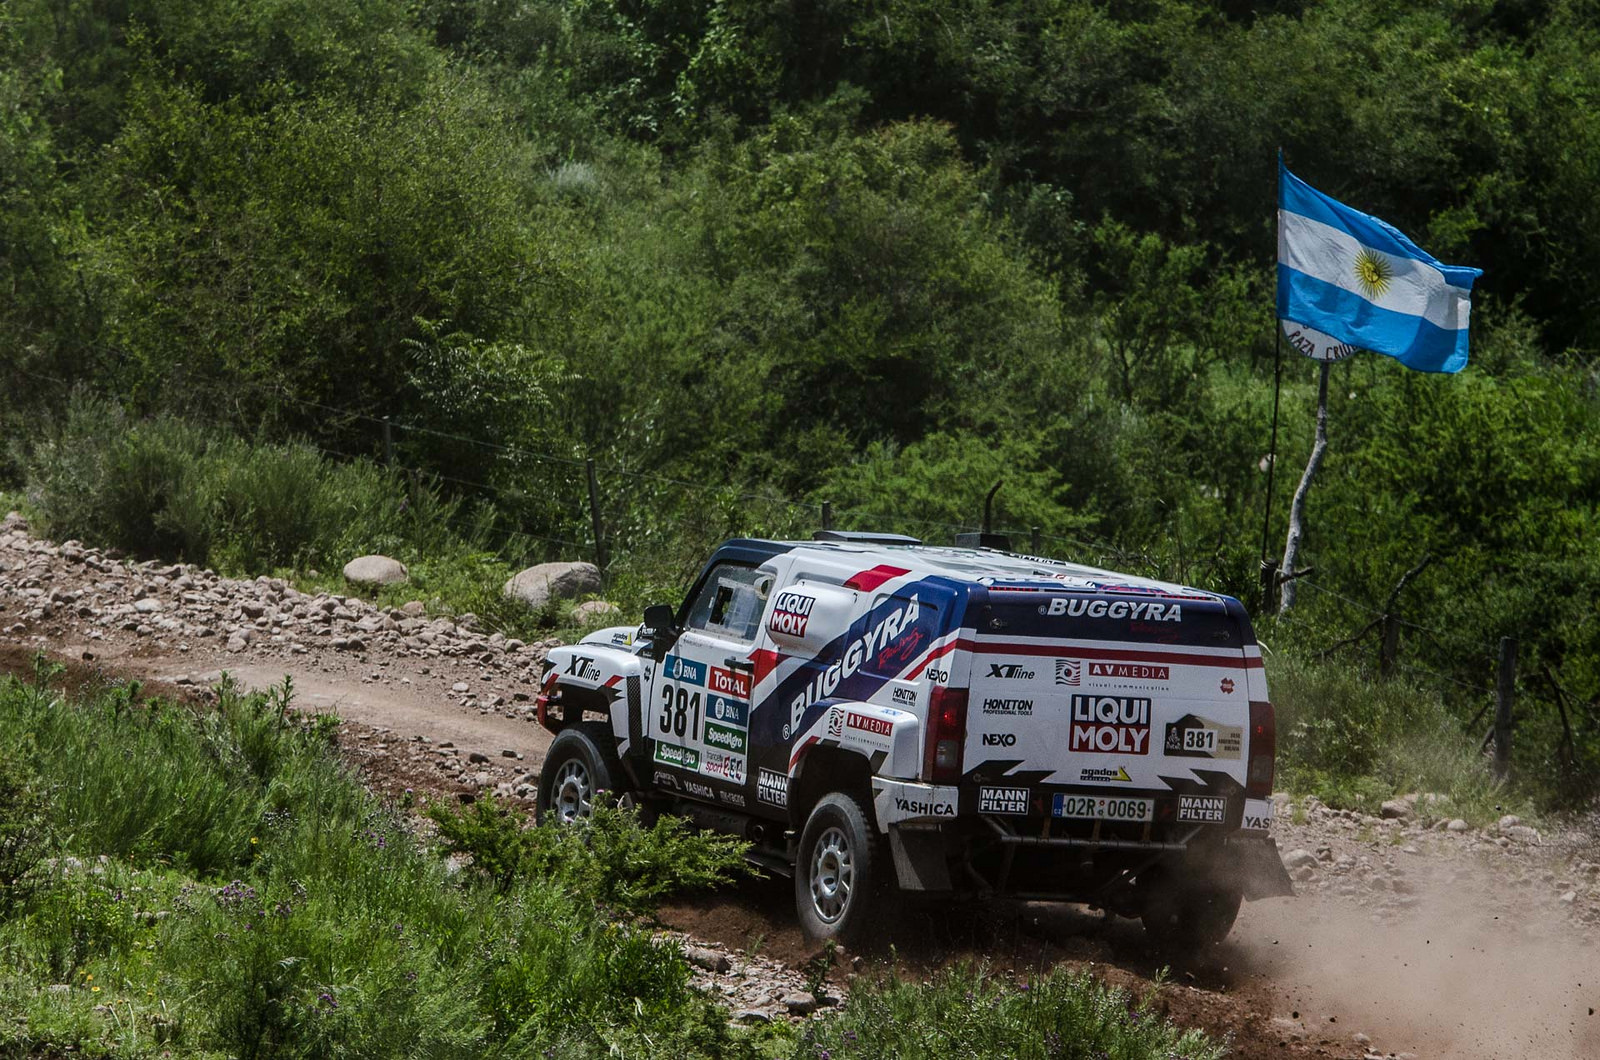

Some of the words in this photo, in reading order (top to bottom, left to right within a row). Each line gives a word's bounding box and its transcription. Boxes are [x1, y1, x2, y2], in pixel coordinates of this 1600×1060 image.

[1288, 331, 1315, 357] RAZA
[776, 592, 815, 616] LIQUI
[1047, 598, 1182, 622] BUGGYRA
[771, 611, 807, 636] MOLY
[564, 654, 601, 681] XTline
[683, 665, 697, 680] BNA
[790, 593, 920, 735] BUGGYRA
[985, 664, 1035, 679] XTline
[925, 668, 948, 683] NEXO
[893, 687, 918, 702] HONITON
[660, 684, 701, 740] 381
[726, 705, 739, 719] BNA
[983, 698, 1033, 711] HONITON
[1074, 696, 1148, 725] LIQUI
[983, 734, 1016, 747] NEXO
[1073, 725, 1149, 753] MOLY
[1186, 731, 1214, 749] 381
[705, 761, 722, 774] sport
[1081, 768, 1118, 778] agados
[684, 780, 715, 799] YASHICA
[760, 771, 787, 791] MANN
[759, 786, 787, 806] FILTER
[982, 789, 1027, 801] MANN
[1180, 797, 1224, 809] MANN
[895, 797, 954, 815] YASHICA
[981, 801, 1026, 812] FILTER
[1066, 797, 1096, 816] 02R
[1108, 800, 1146, 818] 0069
[1179, 808, 1223, 821] FILTER
[1245, 816, 1271, 829] YAS
